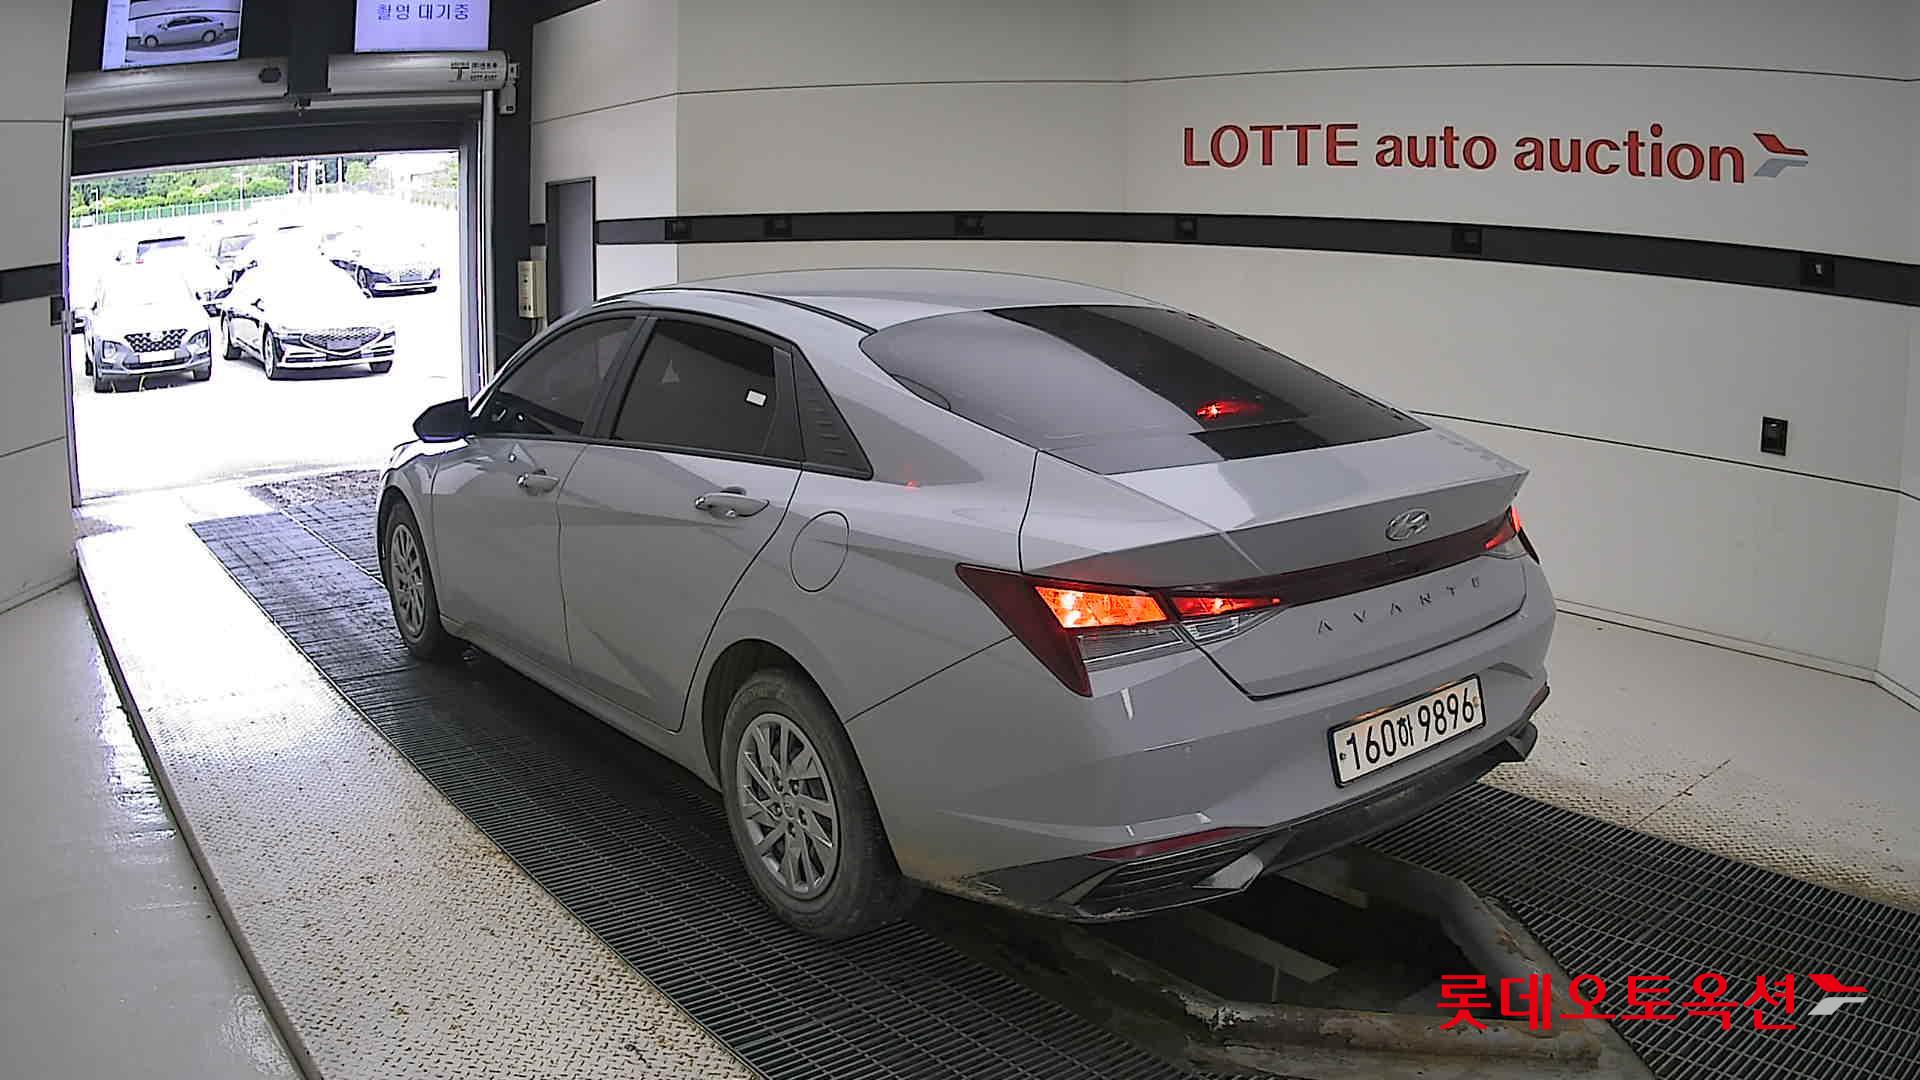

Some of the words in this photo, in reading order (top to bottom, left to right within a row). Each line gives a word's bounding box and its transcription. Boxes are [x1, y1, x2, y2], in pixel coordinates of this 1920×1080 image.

[418, 3, 469, 21] 대기중
[1183, 123, 1359, 168] LOTTE
[1375, 125, 1498, 170] auto
[1513, 122, 1745, 184] auction
[1346, 713, 1414, 771] 160하
[1417, 687, 1475, 743] 9896
